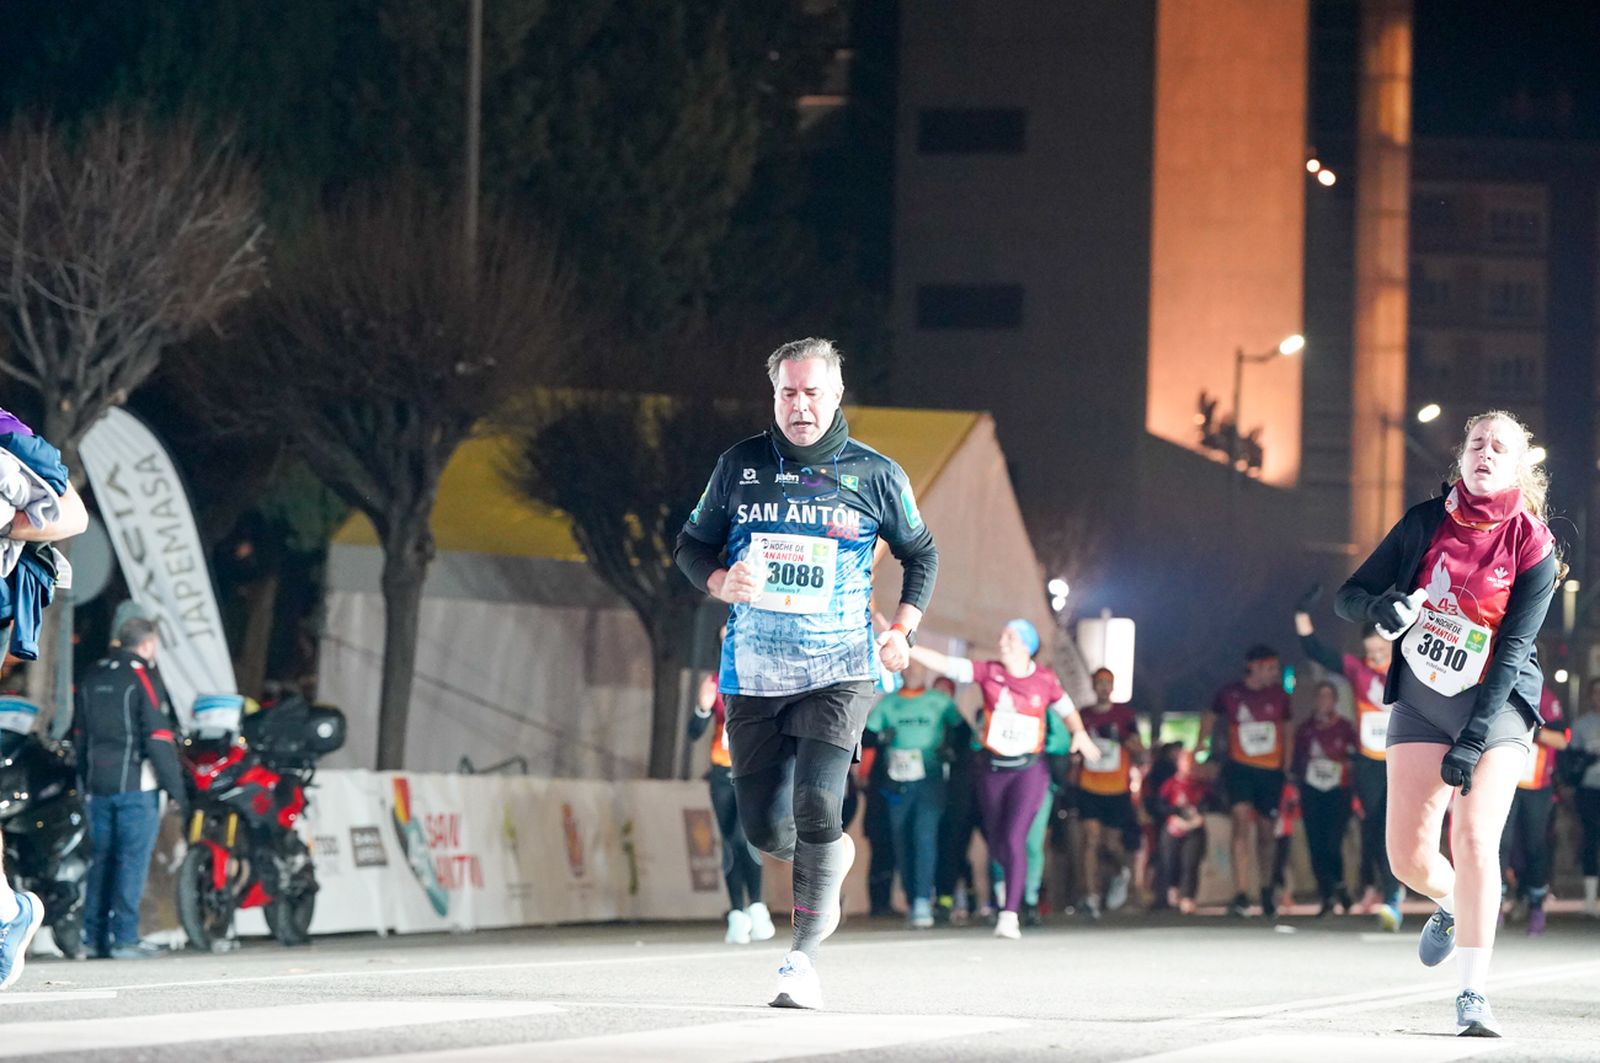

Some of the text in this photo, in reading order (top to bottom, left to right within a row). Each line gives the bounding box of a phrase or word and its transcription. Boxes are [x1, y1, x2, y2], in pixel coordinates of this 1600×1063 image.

[737, 502, 860, 528] SAN ANTÓN
[134, 452, 215, 640] JAPEMASA
[769, 543, 805, 553] NOCHE DE
[767, 561, 824, 588] 3088
[1438, 598, 1458, 616] 43
[1417, 633, 1468, 673] 3810
